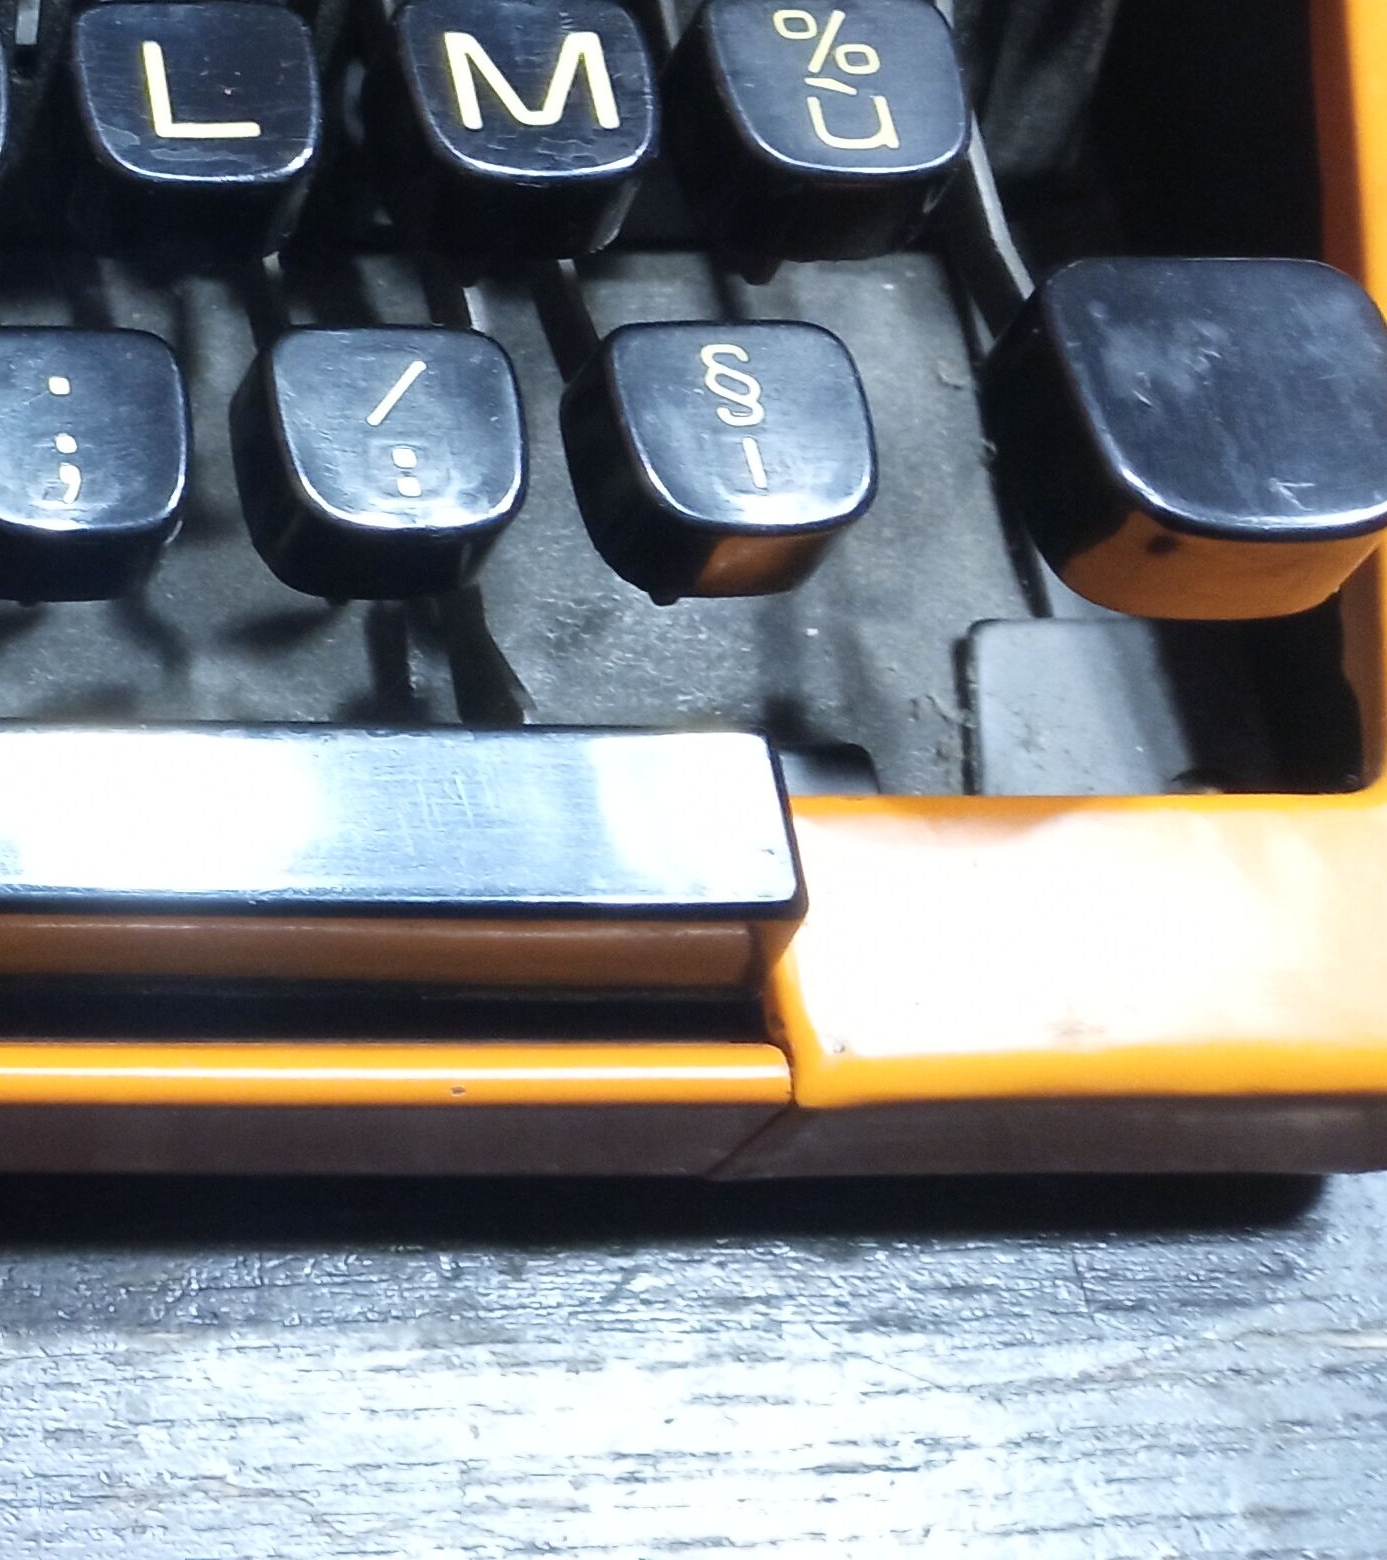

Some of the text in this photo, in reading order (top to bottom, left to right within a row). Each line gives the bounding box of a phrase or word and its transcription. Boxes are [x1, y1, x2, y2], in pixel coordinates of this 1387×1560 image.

[142, 40, 261, 139] L
[443, 31, 620, 130] M
[772, 9, 882, 75] %
